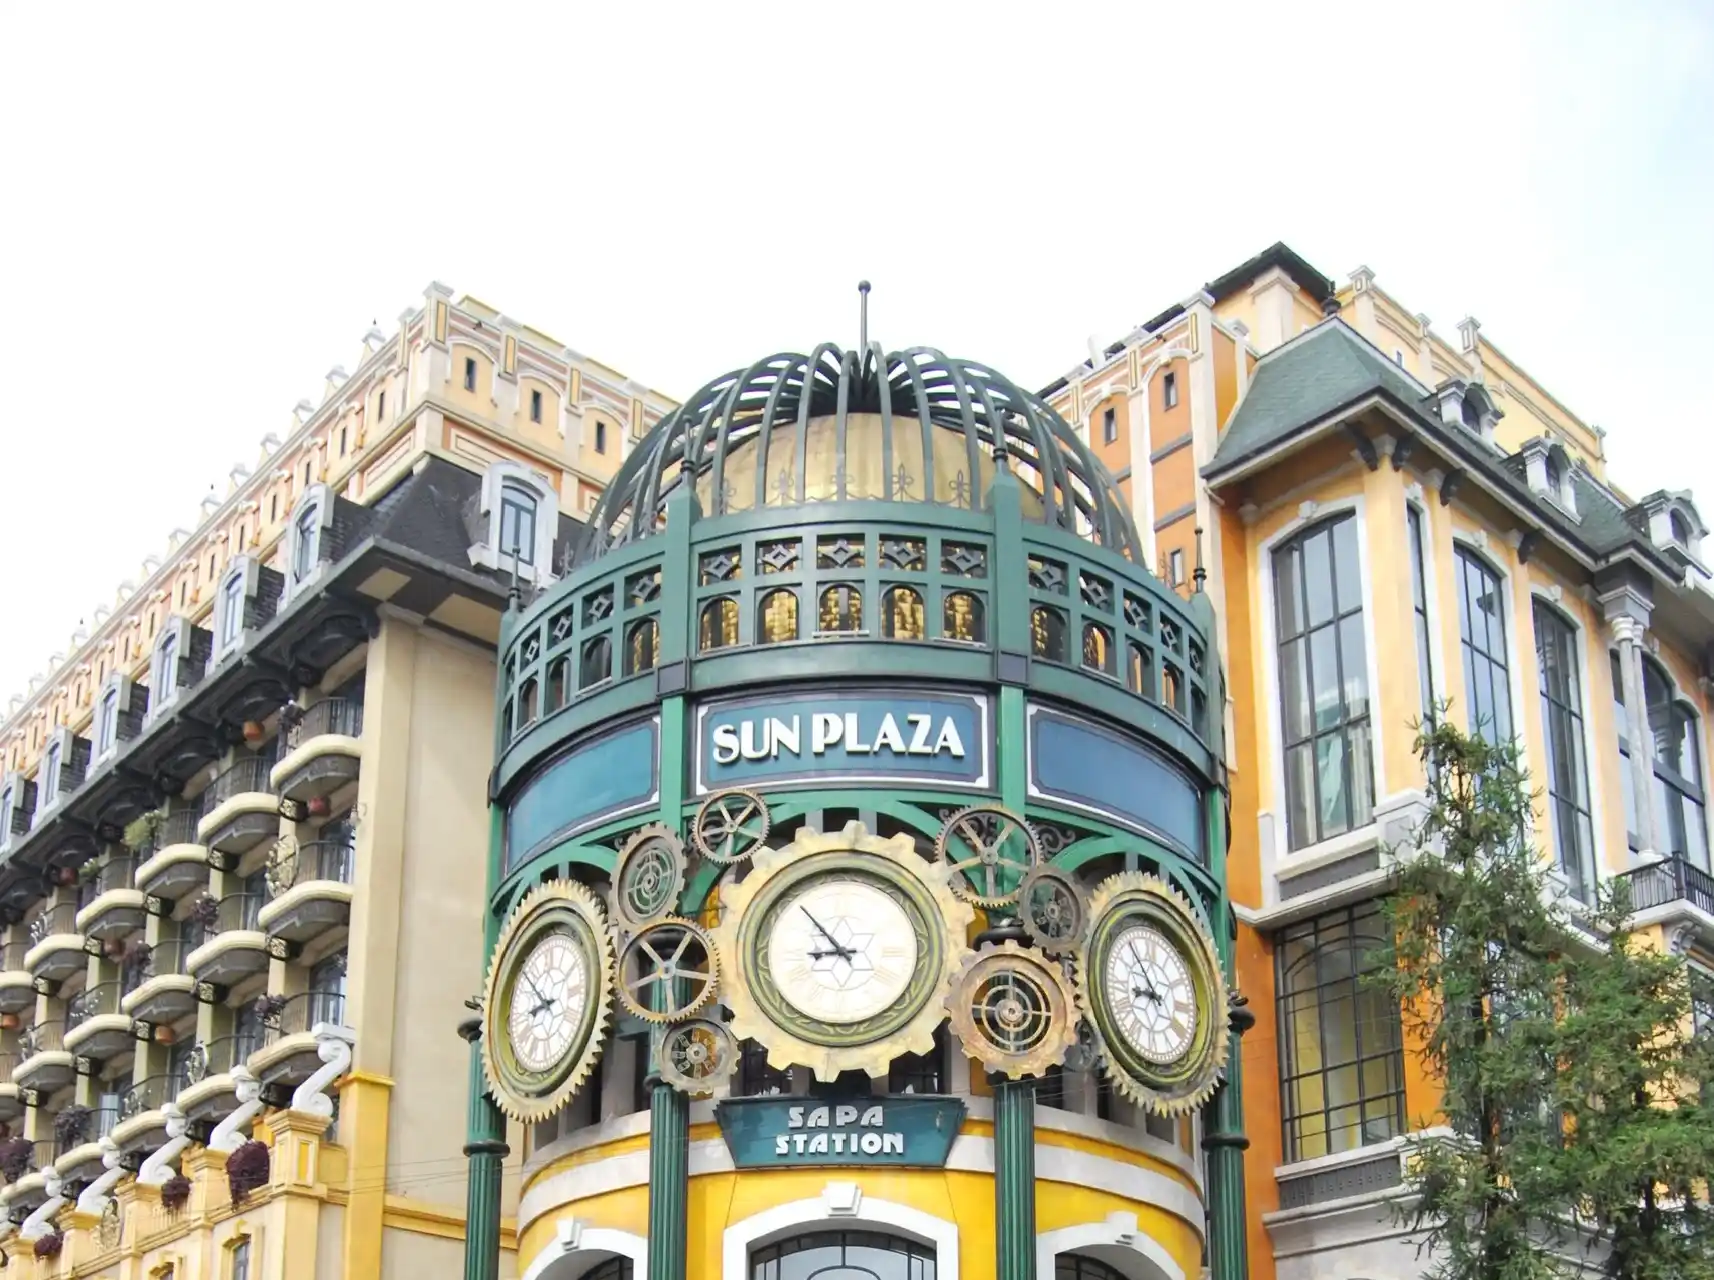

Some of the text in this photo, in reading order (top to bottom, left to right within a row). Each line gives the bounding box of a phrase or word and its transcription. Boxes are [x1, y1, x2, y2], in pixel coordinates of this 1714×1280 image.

[713, 712, 966, 764] SUN PLAZA
[788, 1105, 885, 1129] SAPA
[775, 1132, 905, 1155] STATION
